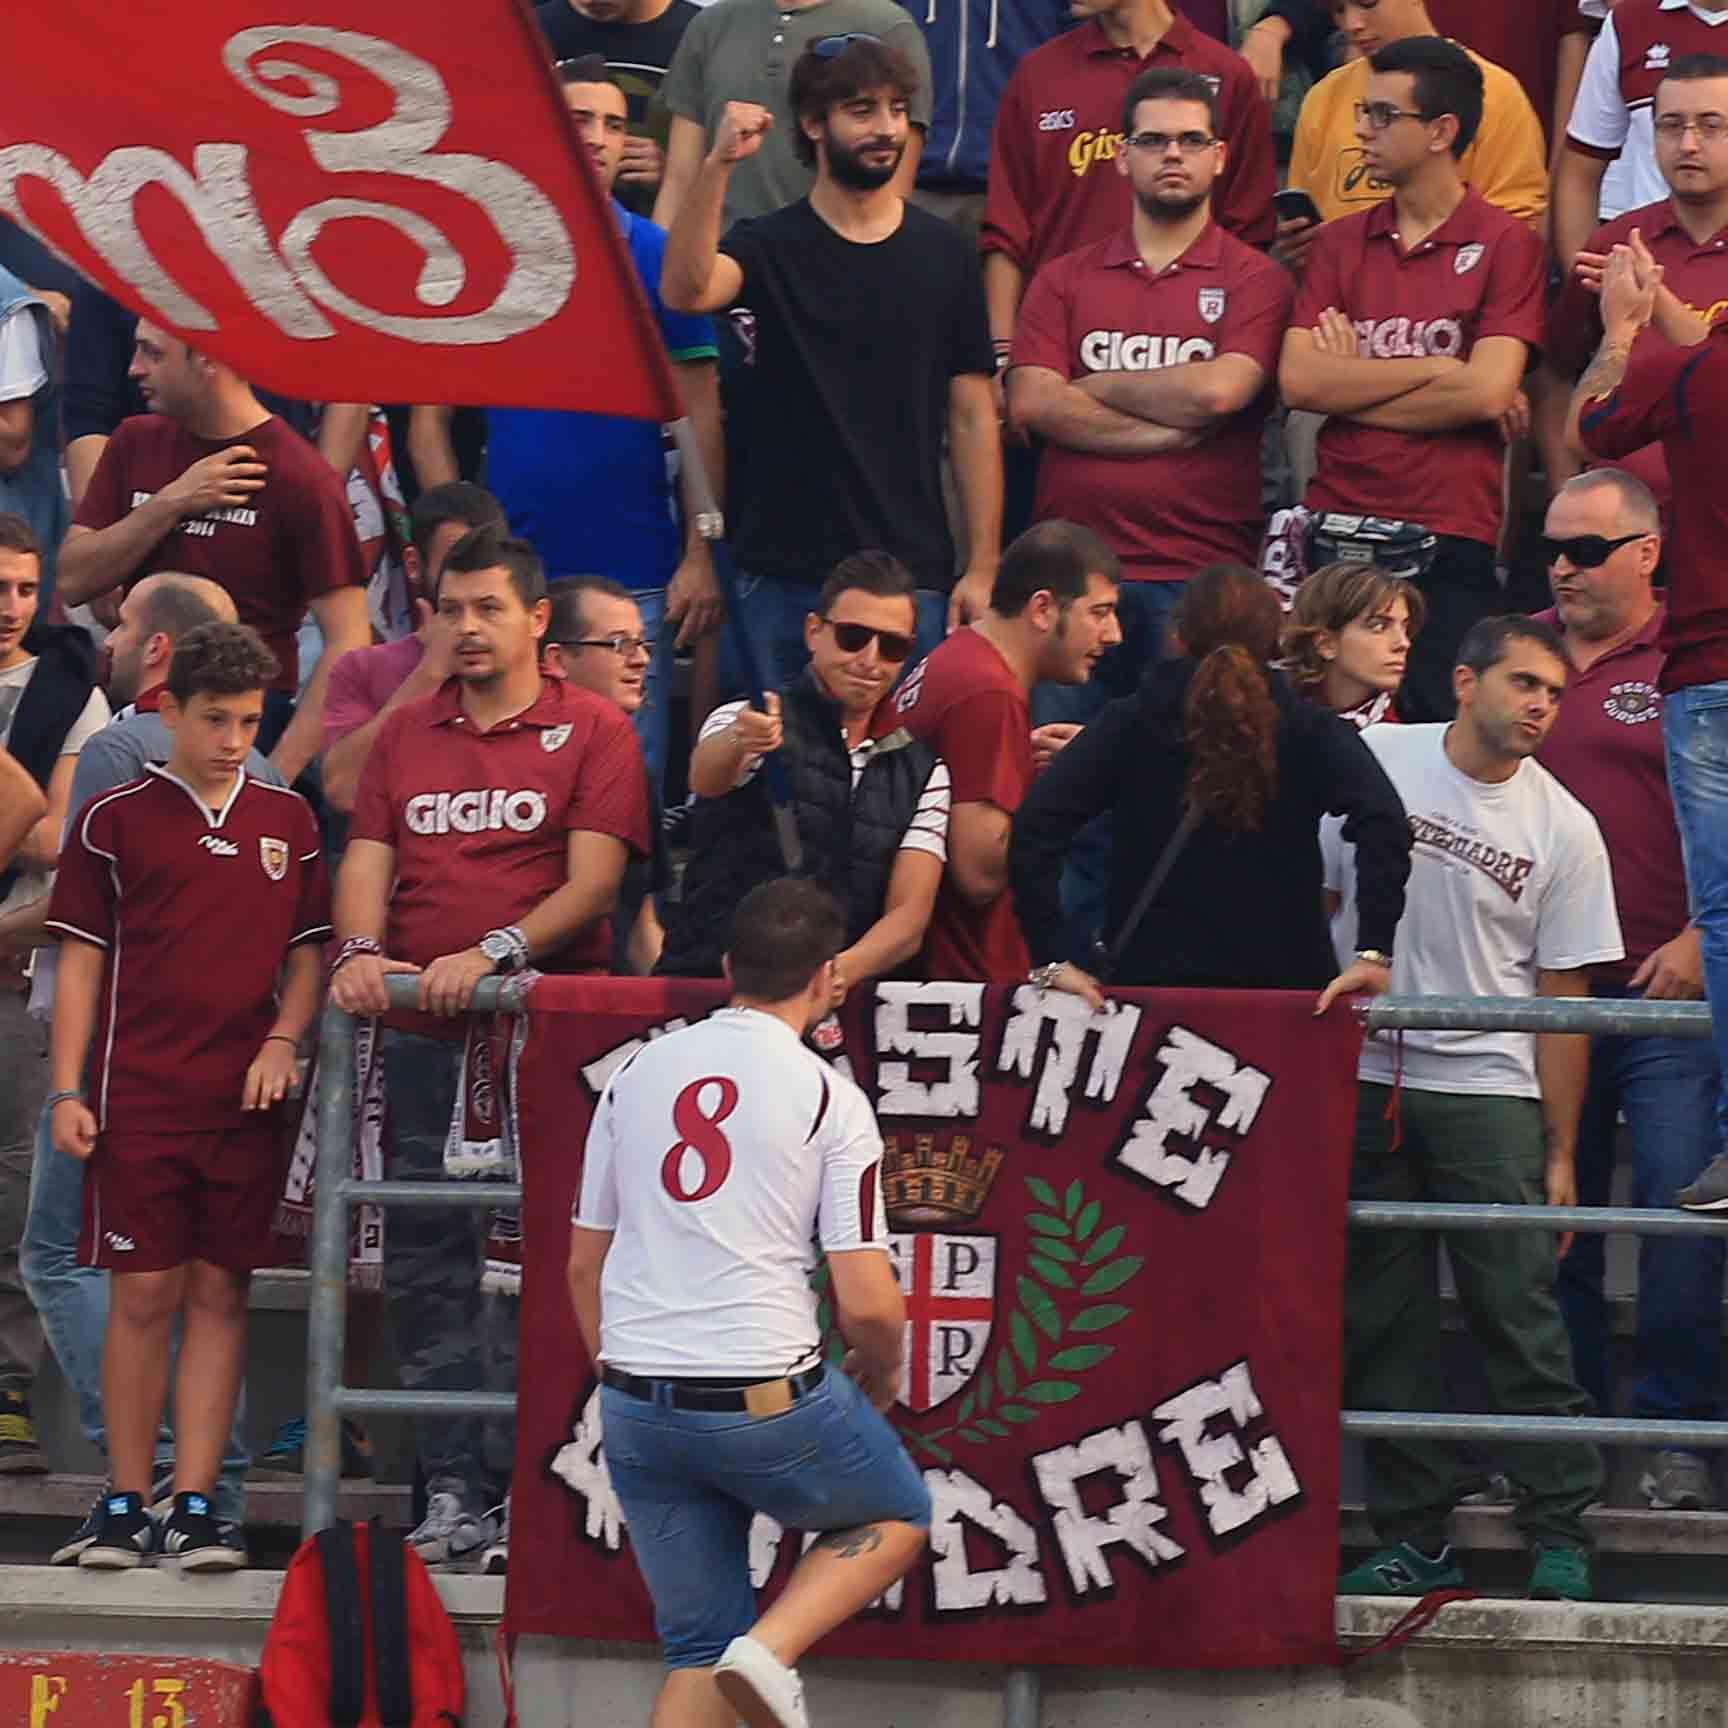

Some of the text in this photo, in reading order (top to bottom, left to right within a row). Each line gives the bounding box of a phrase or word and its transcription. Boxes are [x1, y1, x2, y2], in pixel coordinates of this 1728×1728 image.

[1038, 106, 1076, 132] asics
[404, 787, 547, 835] GIGLIO
[659, 1074, 740, 1204] 8
[943, 1241, 980, 1291] P
[939, 1324, 976, 1376] R
[28, 1673, 70, 1728] F
[124, 1677, 187, 1728] 13
